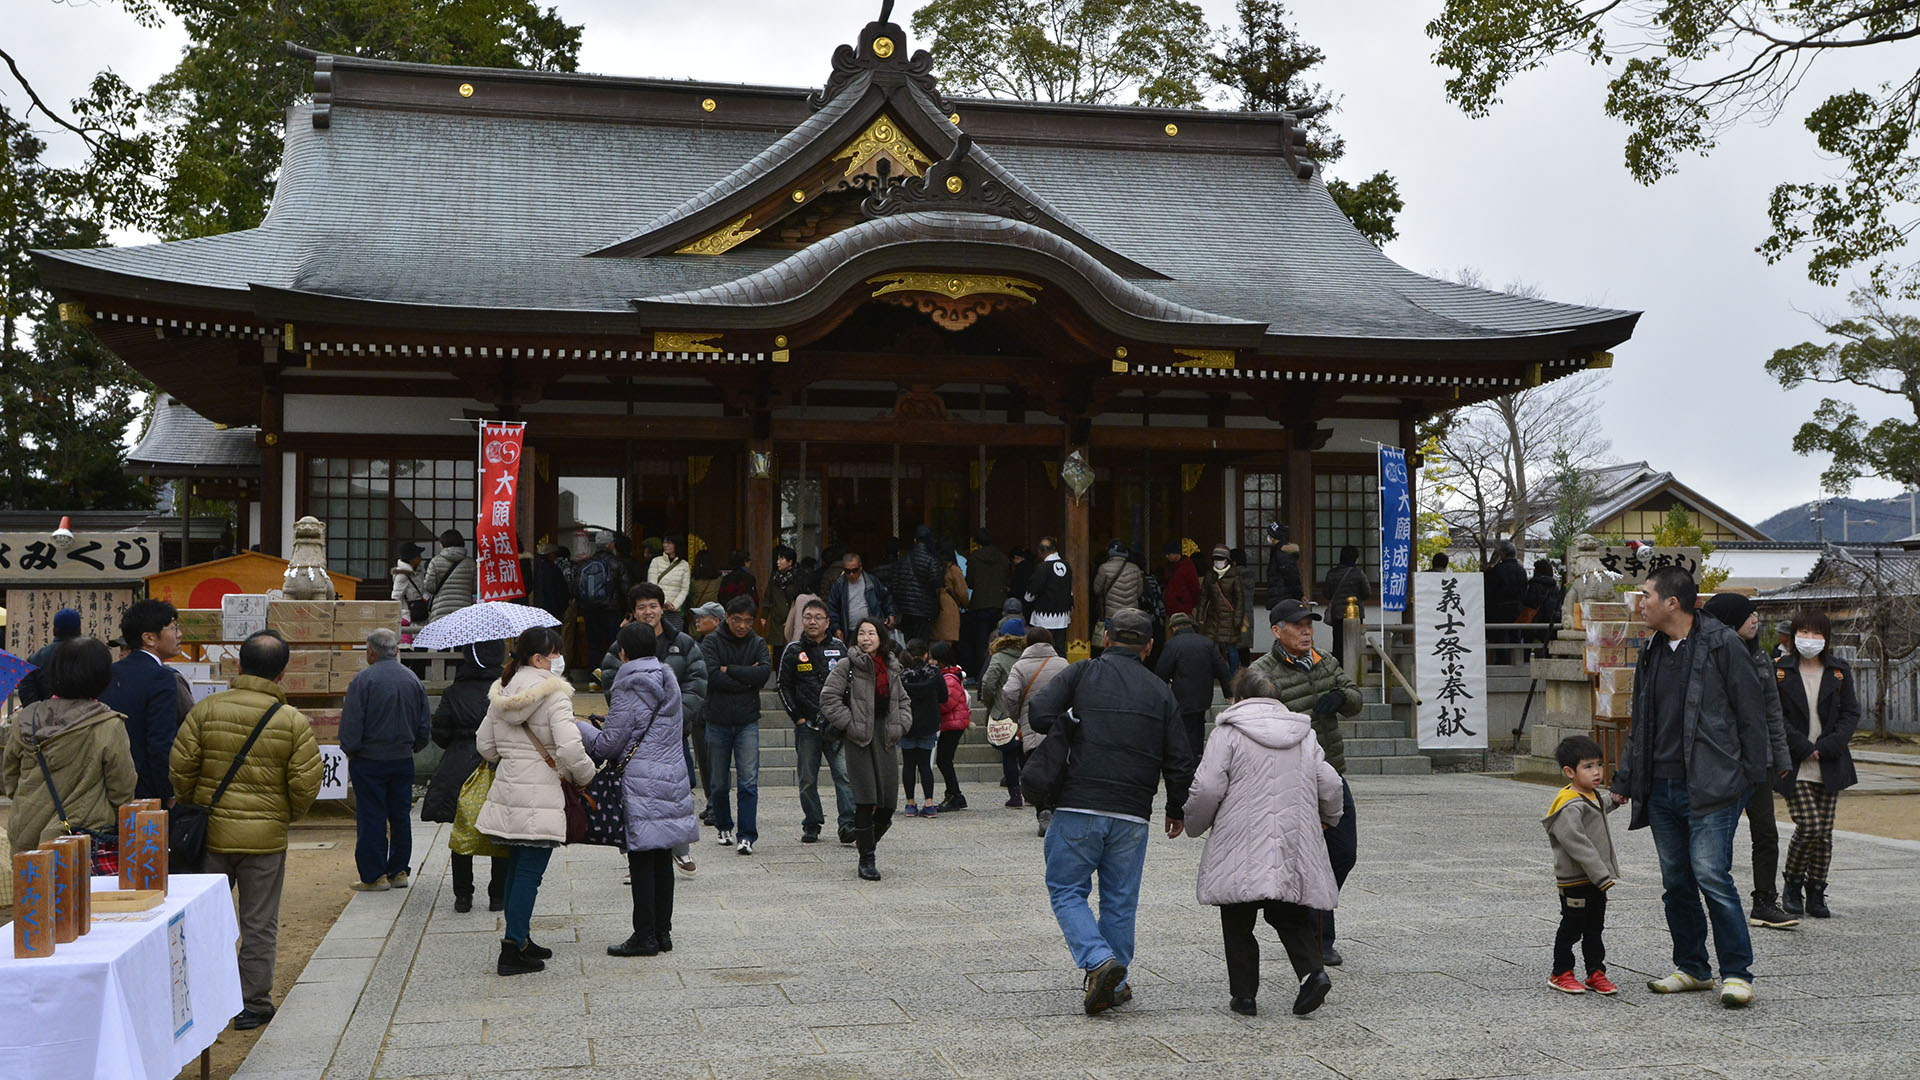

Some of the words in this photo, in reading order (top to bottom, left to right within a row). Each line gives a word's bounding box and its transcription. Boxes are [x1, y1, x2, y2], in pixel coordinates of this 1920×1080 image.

[480, 534, 497, 584] 大石神社
[492, 469, 519, 583] 大願成就
[1389, 488, 1410, 596] 大願成就
[140, 819, 160, 890] 水みくじ
[19, 860, 42, 951] 水みくじ
